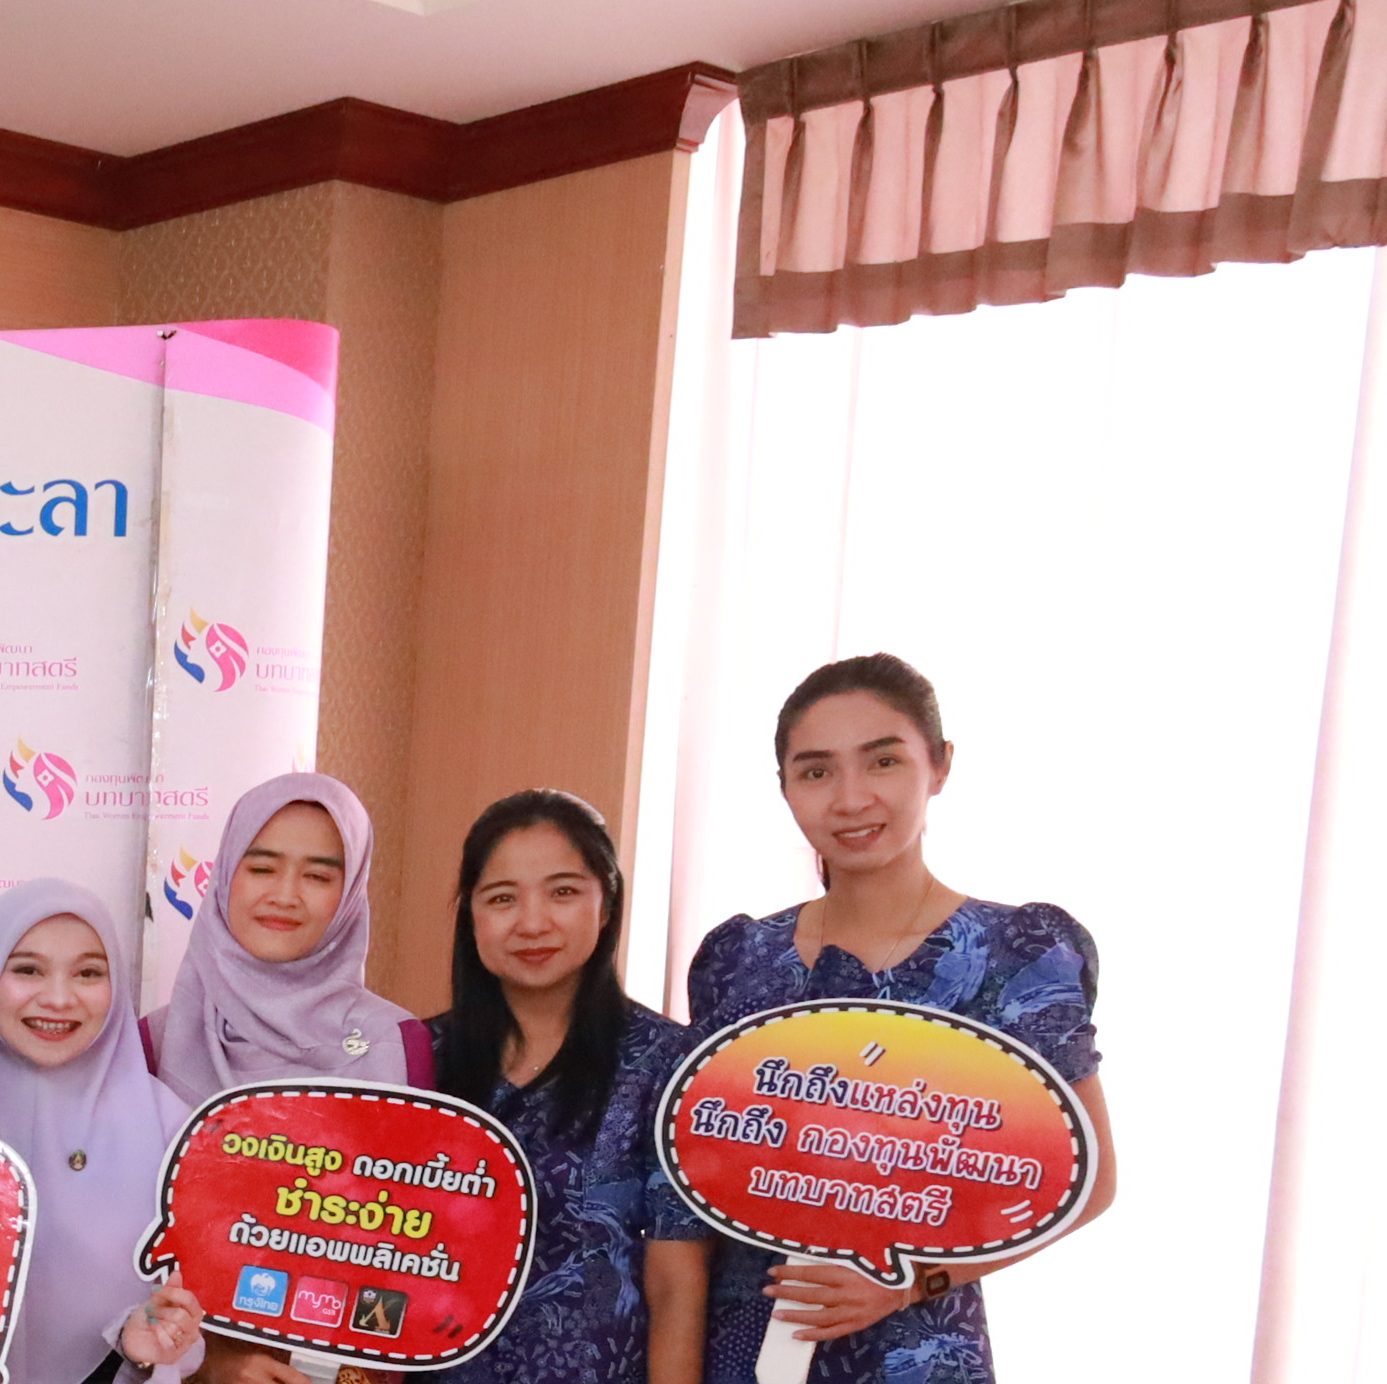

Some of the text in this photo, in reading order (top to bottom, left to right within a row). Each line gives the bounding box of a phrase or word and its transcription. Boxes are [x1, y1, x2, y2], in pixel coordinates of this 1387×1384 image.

[754, 1057, 1002, 1134] นึกถึงแหล่งทุน
[222, 1132, 497, 1198] วงเงินสูง ดอกเบี้ยต่ำ
[690, 1098, 1043, 1190] นึกถึง กองทุนพัฒนา
[275, 1177, 433, 1239] ชำระง่าย
[748, 1165, 952, 1227] บทบาทสตรี
[228, 1213, 461, 1282] ด้วยแอพพลิเคชั่น
